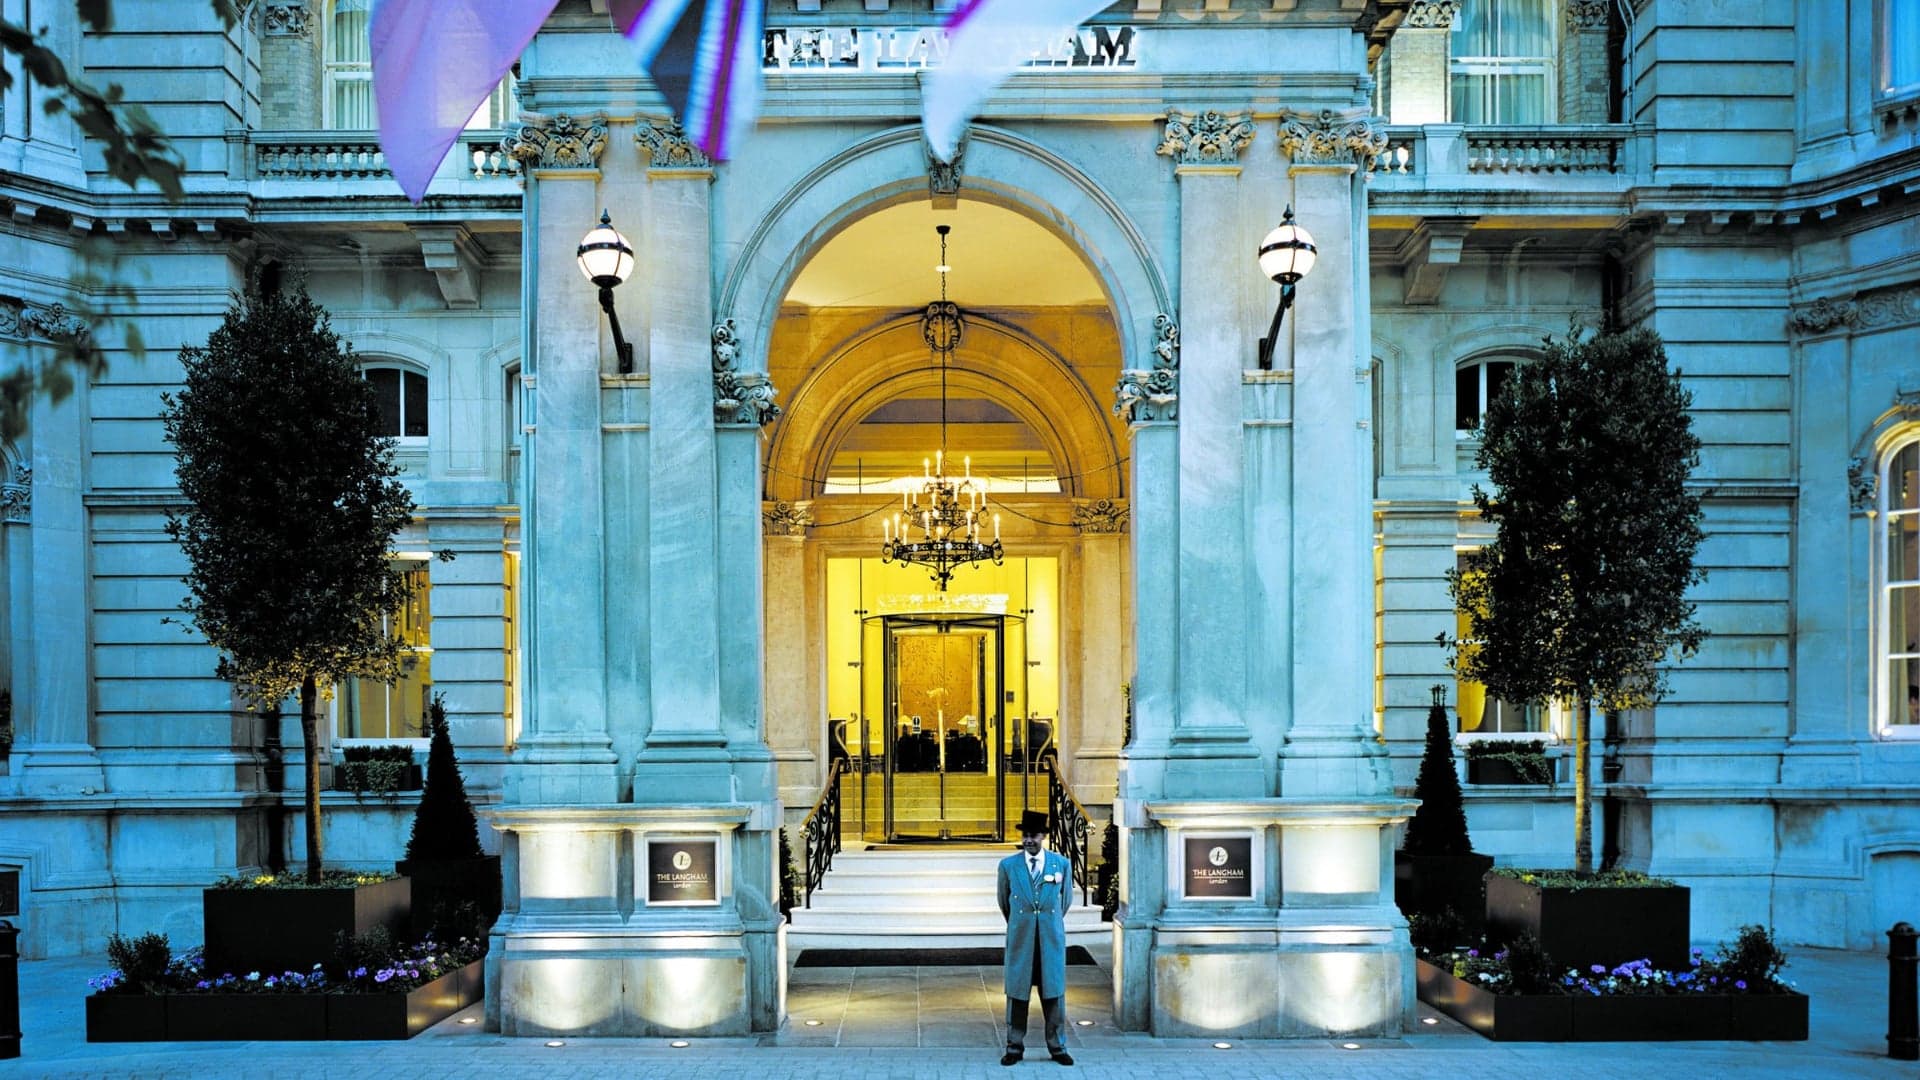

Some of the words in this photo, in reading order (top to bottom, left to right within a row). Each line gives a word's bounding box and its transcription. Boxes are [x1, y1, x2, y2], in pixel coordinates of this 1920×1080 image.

[762, 28, 859, 67] THE
[657, 873, 671, 881] THE
[672, 873, 708, 881] LANGHAM
